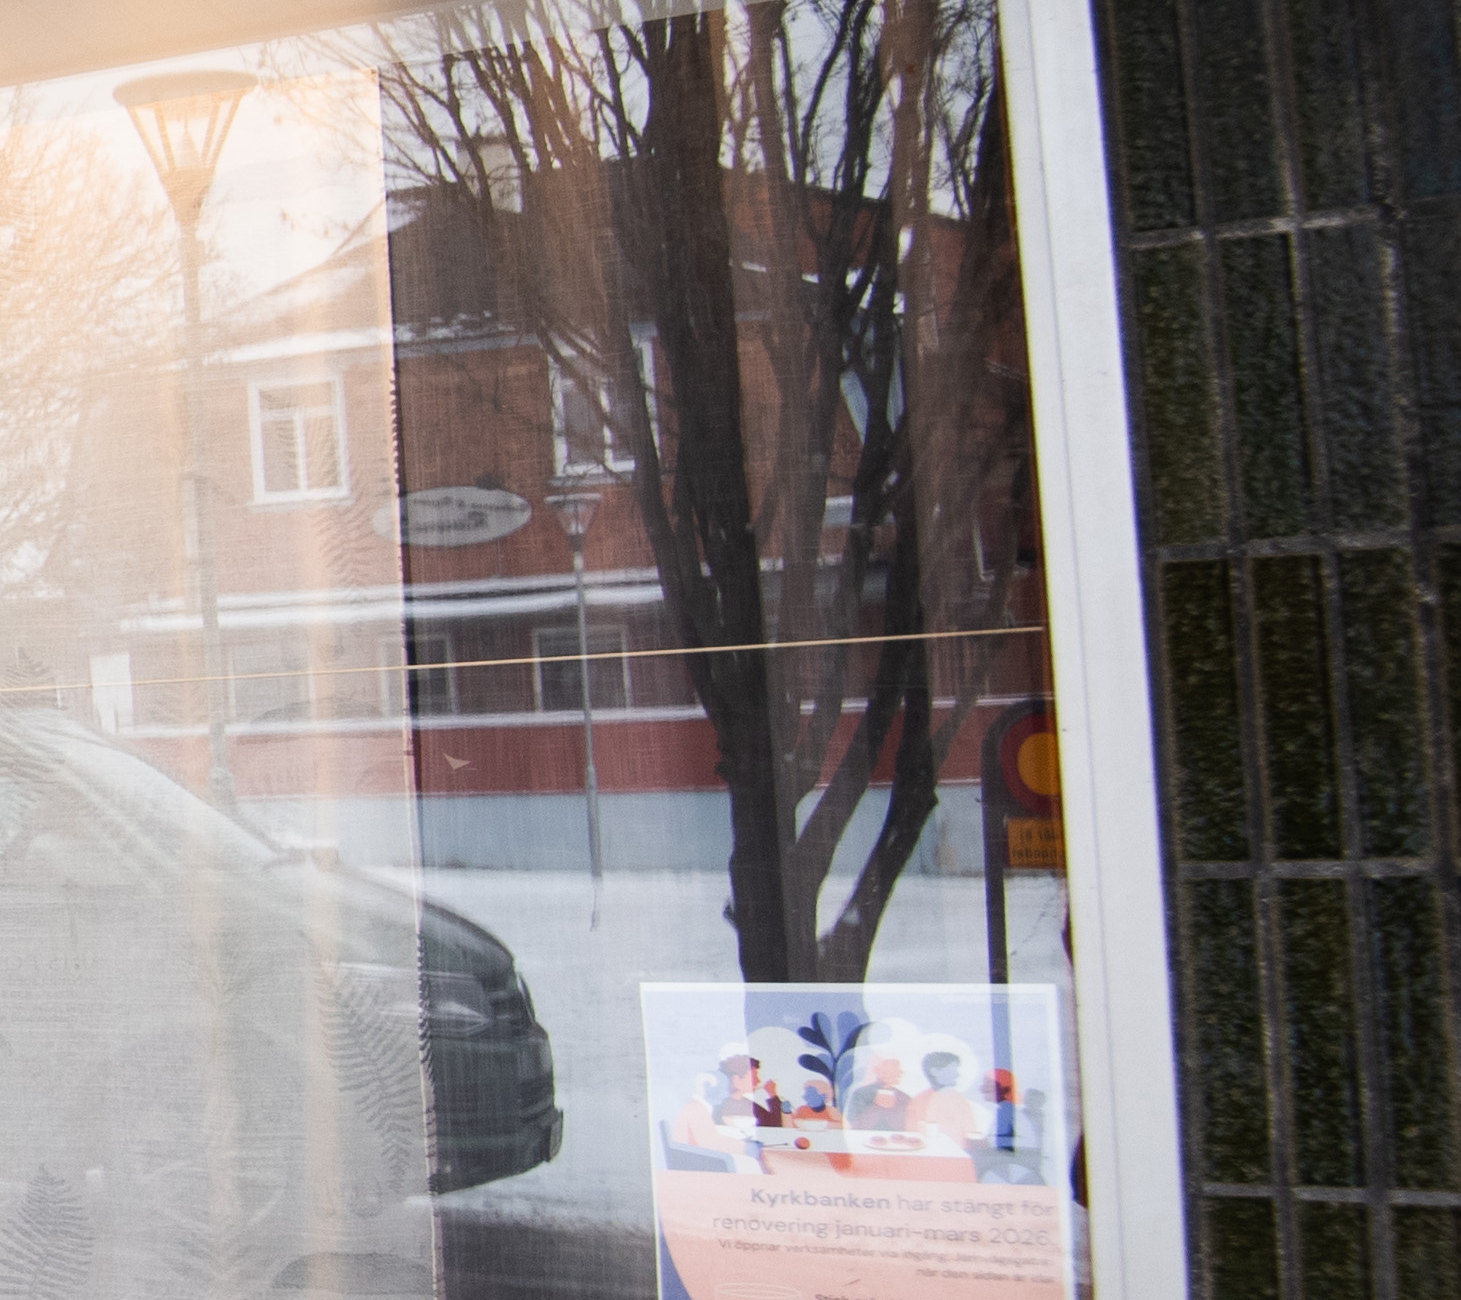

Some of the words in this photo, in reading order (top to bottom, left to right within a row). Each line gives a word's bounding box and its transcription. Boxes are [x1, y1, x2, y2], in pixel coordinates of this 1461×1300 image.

[751, 1188, 891, 1210] Kyrkbanken
[897, 1194, 932, 1211] har
[940, 1198, 1015, 1218] stängt
[1021, 1199, 1054, 1217] för
[712, 1215, 828, 1237] renovering
[734, 1238, 782, 1253] öppnar
[785, 1242, 874, 1257] verksamheter
[943, 1268, 969, 1278] den
